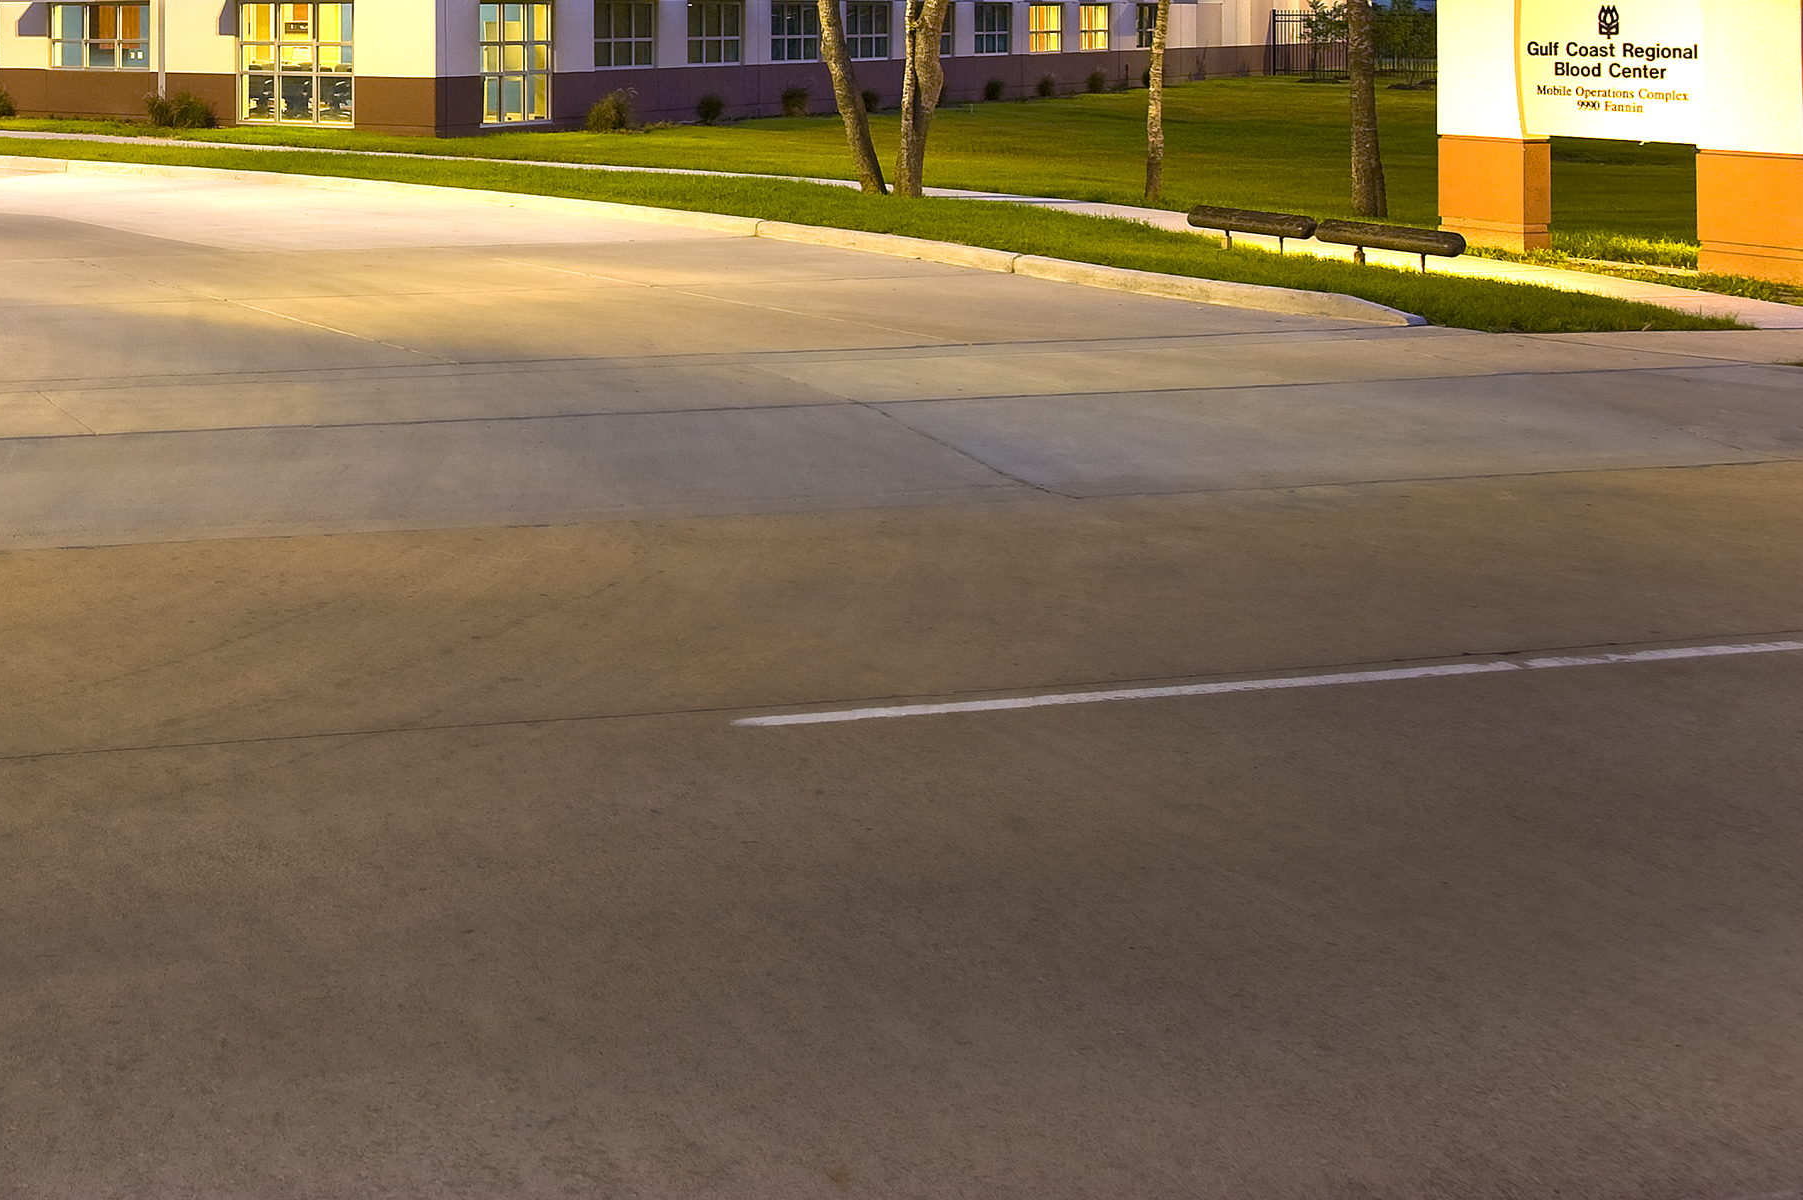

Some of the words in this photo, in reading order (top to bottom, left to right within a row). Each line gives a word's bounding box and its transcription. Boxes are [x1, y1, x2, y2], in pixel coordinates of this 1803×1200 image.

[1527, 41, 1559, 56] Gulf
[1566, 42, 1615, 57] Coast
[1622, 43, 1698, 61] Regional
[1554, 62, 1601, 77] Blood
[1609, 63, 1667, 79] Center
[1536, 85, 1572, 96] Mobile
[1575, 86, 1634, 99] Operations
[1638, 88, 1689, 102] Complex
[1577, 100, 1600, 111] 9990
[1604, 101, 1644, 113] Fannin
